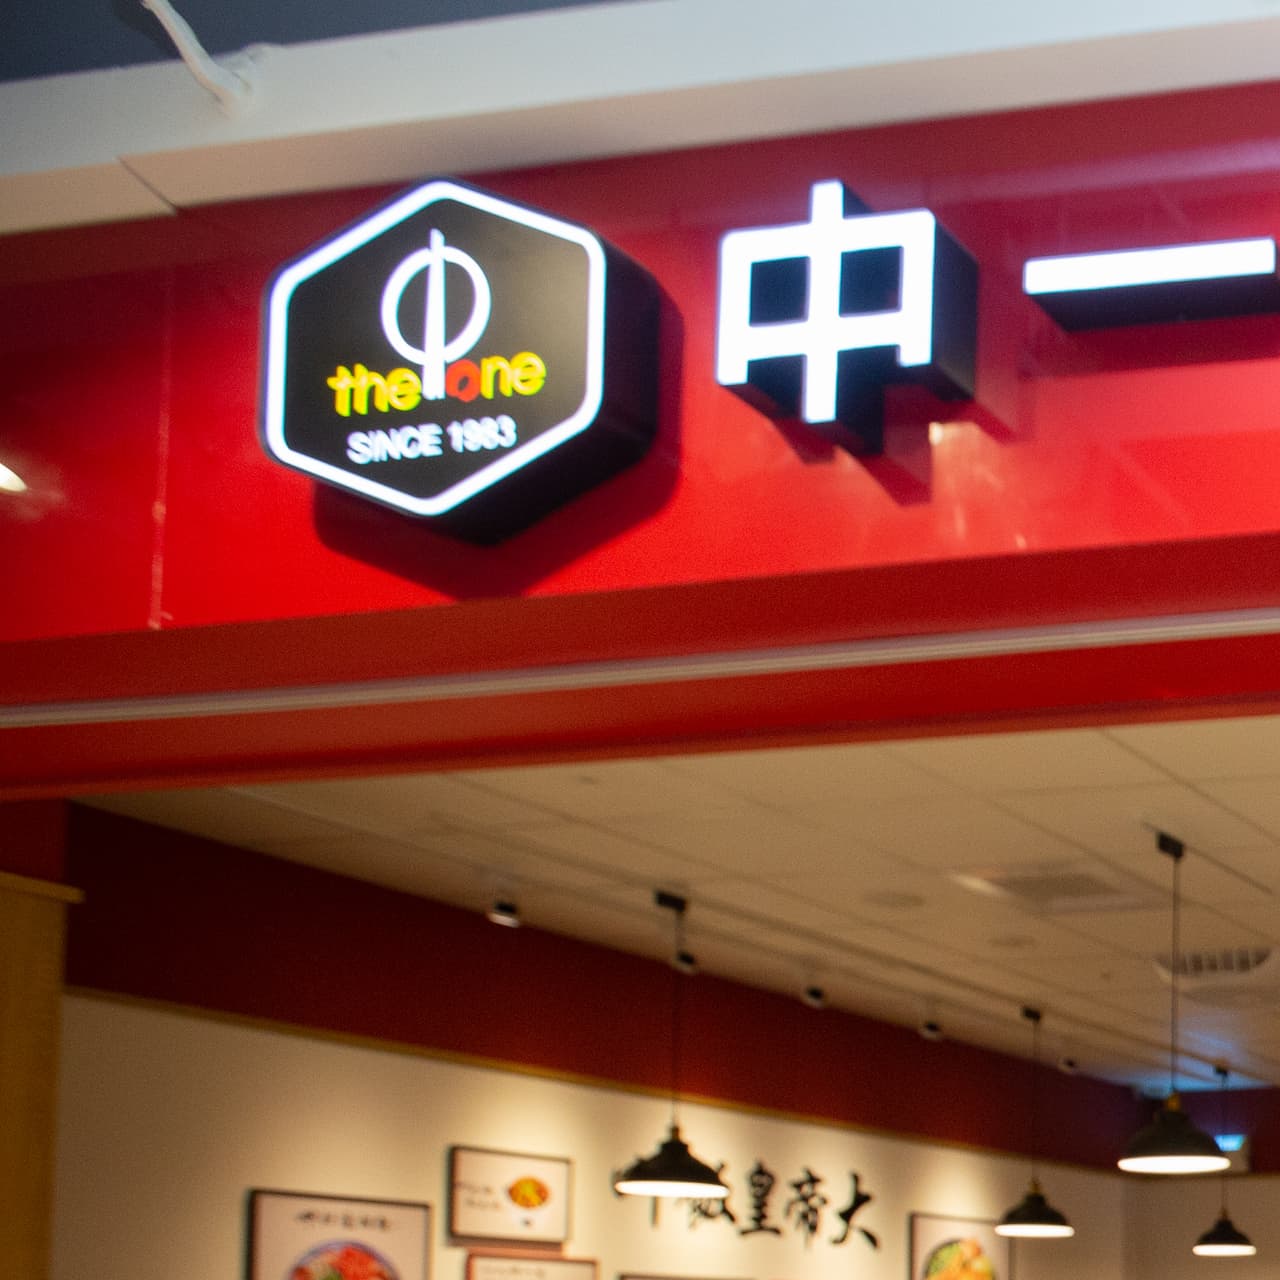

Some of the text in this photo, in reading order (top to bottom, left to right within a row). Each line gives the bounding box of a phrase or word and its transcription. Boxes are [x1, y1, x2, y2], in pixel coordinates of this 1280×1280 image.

[327, 352, 547, 417] the one
[347, 414, 518, 464] SINCE 1983
